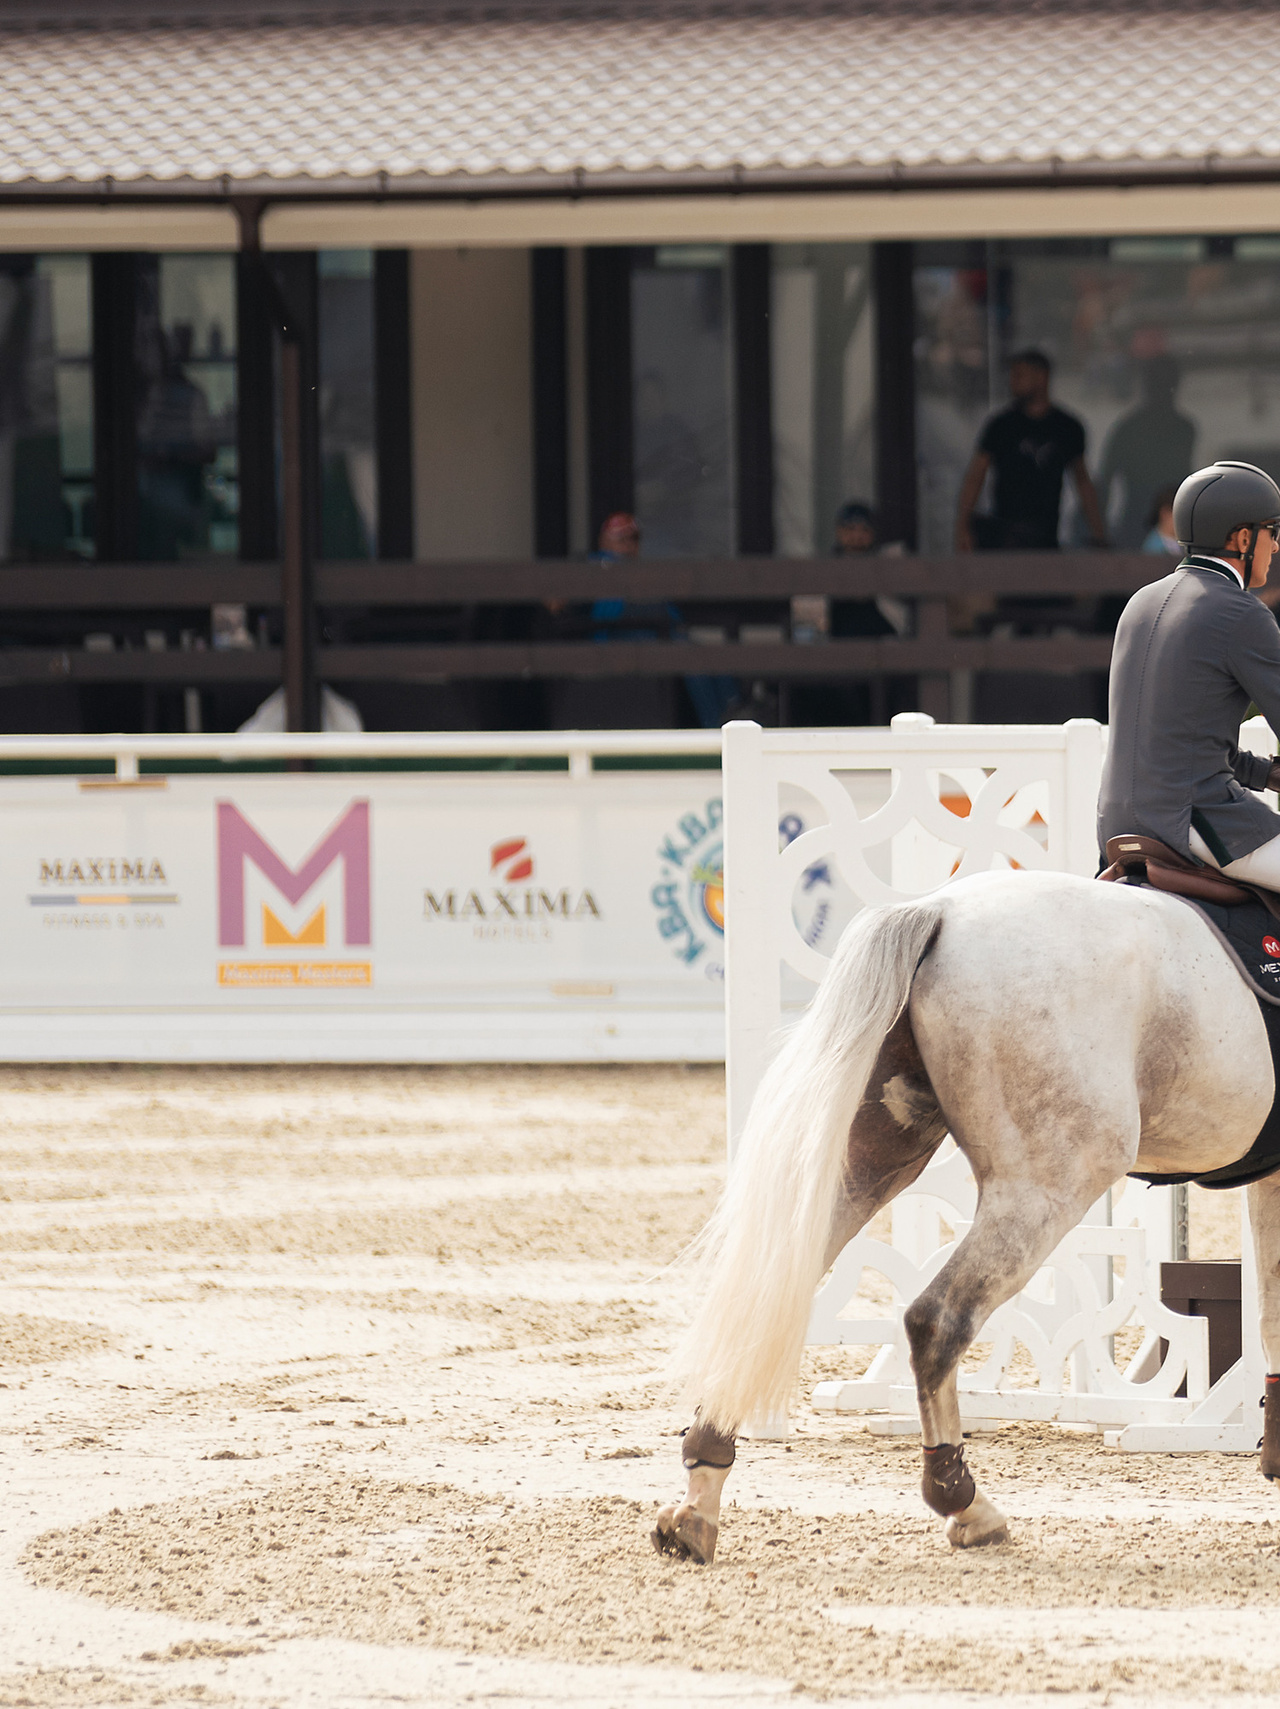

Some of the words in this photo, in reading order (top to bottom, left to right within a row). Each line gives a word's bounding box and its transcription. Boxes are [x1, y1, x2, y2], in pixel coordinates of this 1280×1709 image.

[39, 858, 167, 885] MAXIMA
[423, 889, 603, 920] MAXIMA
[1265, 941, 1280, 953] M
